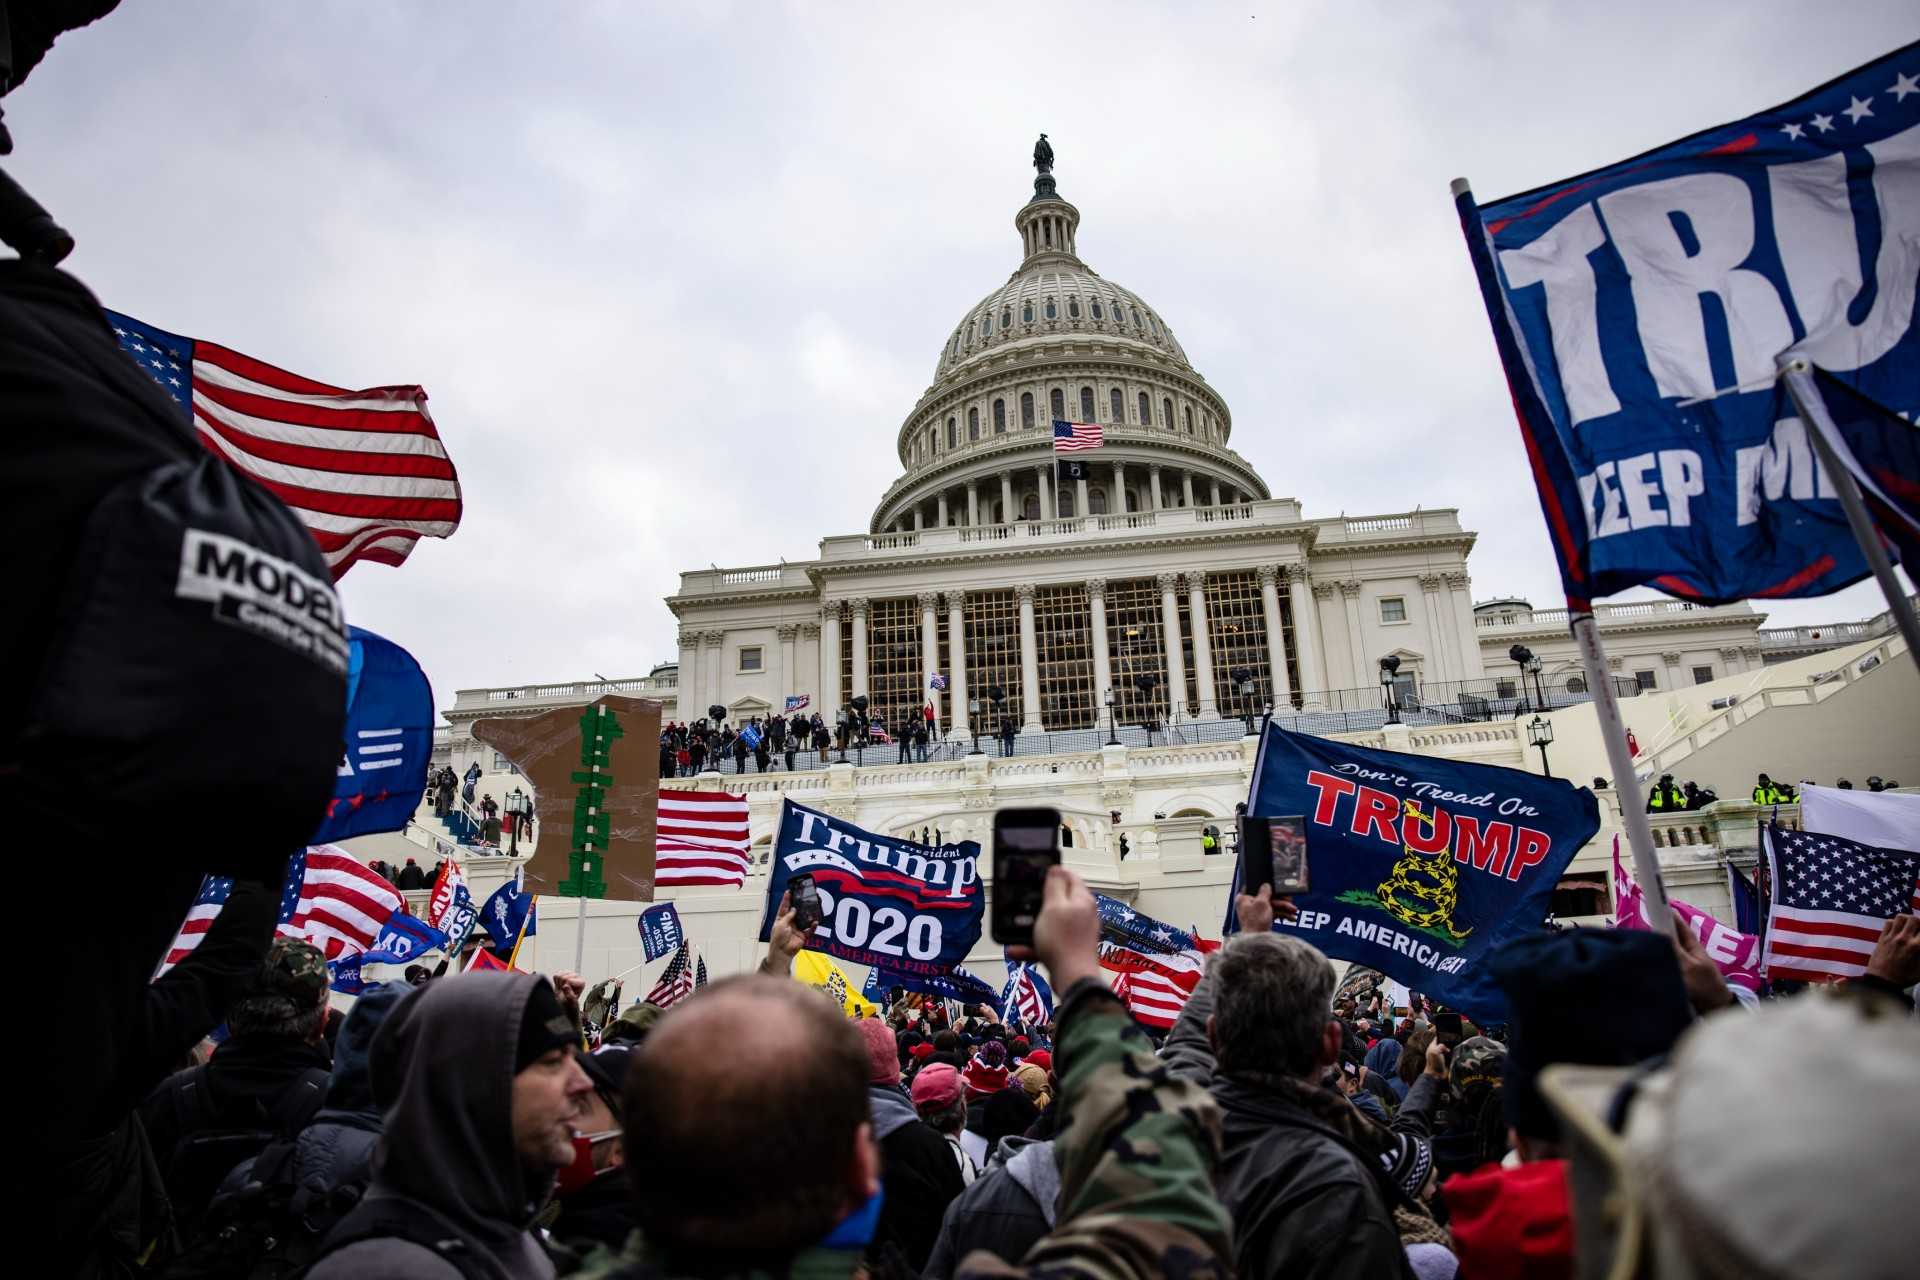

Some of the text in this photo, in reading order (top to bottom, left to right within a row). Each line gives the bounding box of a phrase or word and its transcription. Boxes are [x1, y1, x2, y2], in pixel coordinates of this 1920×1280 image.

[1331, 763, 1539, 817] Don't Tread On
[791, 807, 976, 898] Trump
[1306, 769, 1552, 882] TRUMP
[812, 886, 943, 961] 2020
[1274, 909, 1331, 930] EEP
[1336, 915, 1440, 970] AMERICA
[828, 943, 900, 968] AMERICA
[904, 959, 950, 976] FIRST
